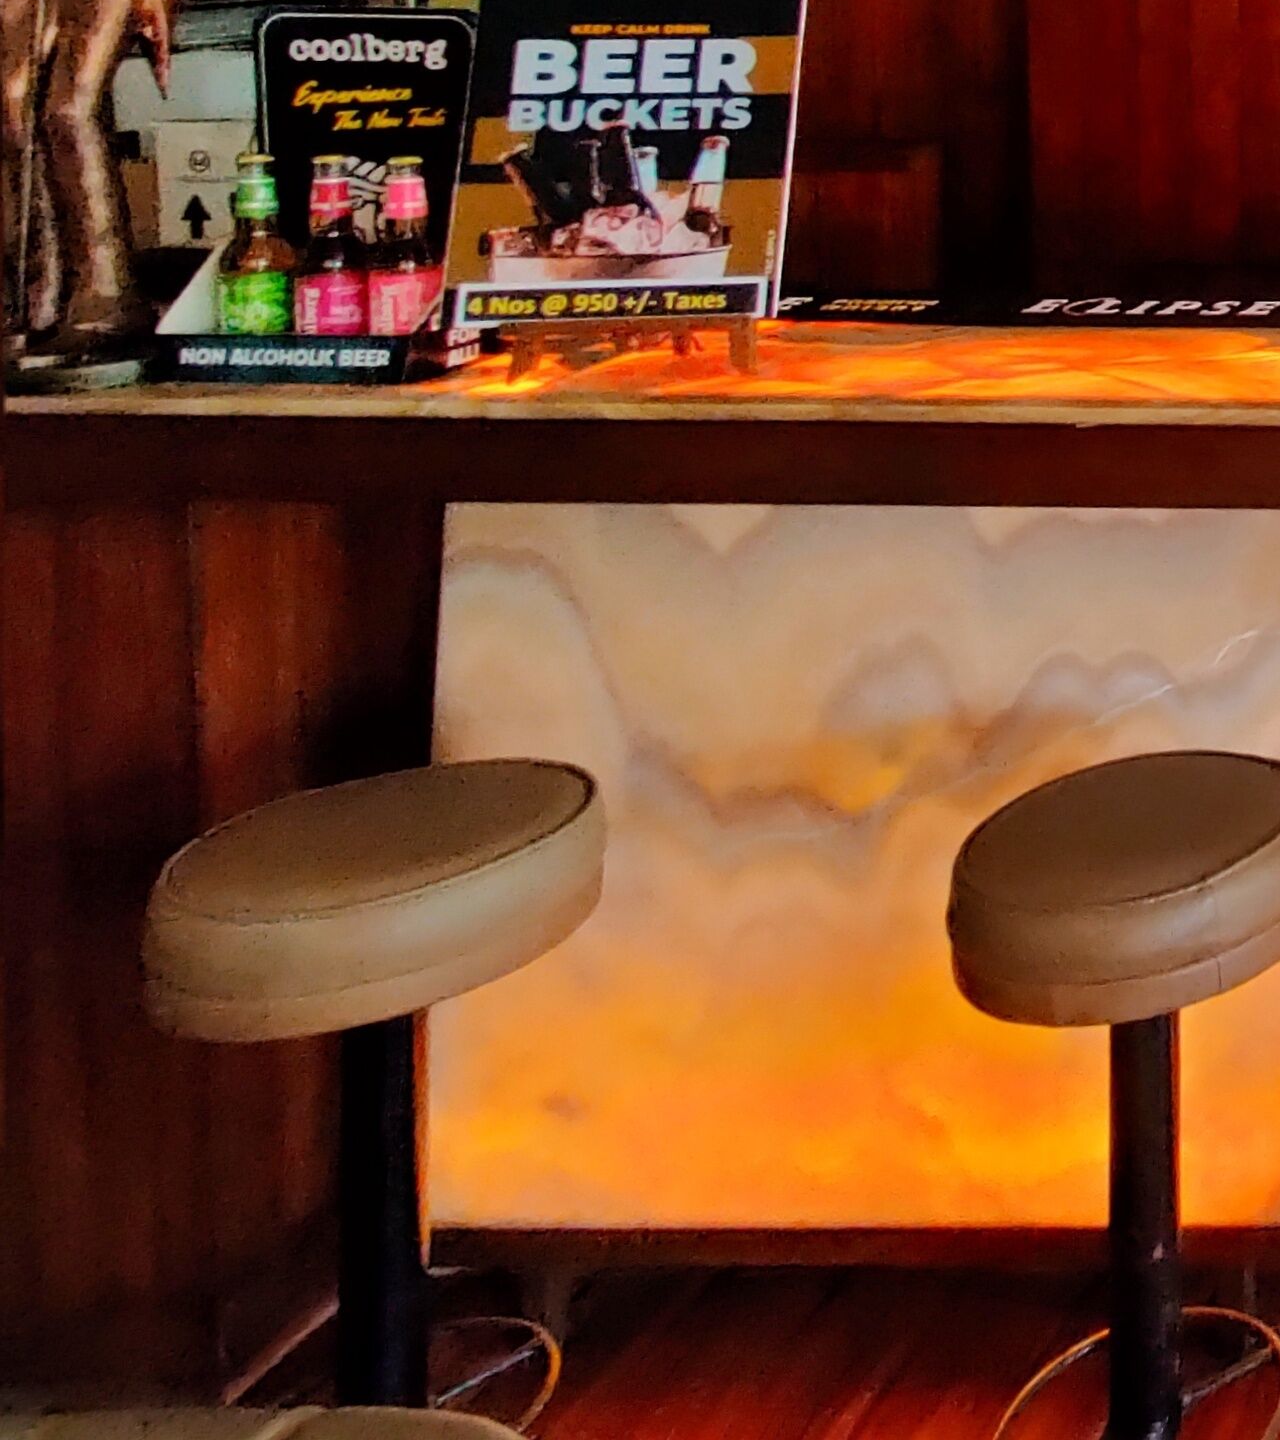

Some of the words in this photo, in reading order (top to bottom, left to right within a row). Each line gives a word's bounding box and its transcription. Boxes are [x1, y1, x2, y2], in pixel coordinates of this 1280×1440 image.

[570, 23, 613, 35] KEEP
[617, 23, 660, 35] CALM
[663, 23, 711, 35] DRINK
[289, 33, 448, 70] coolberg
[510, 38, 758, 95] BEER
[291, 80, 413, 114] Experience
[507, 96, 752, 132] BUCKETS
[467, 296, 484, 315] 4
[489, 295, 535, 315] Nos
[542, 294, 568, 316] @
[573, 292, 618, 313] 950
[663, 291, 727, 310] Taxes
[178, 347, 226, 366] NON
[229, 348, 335, 367] ALCOHOLIC
[338, 349, 391, 368] BEER
